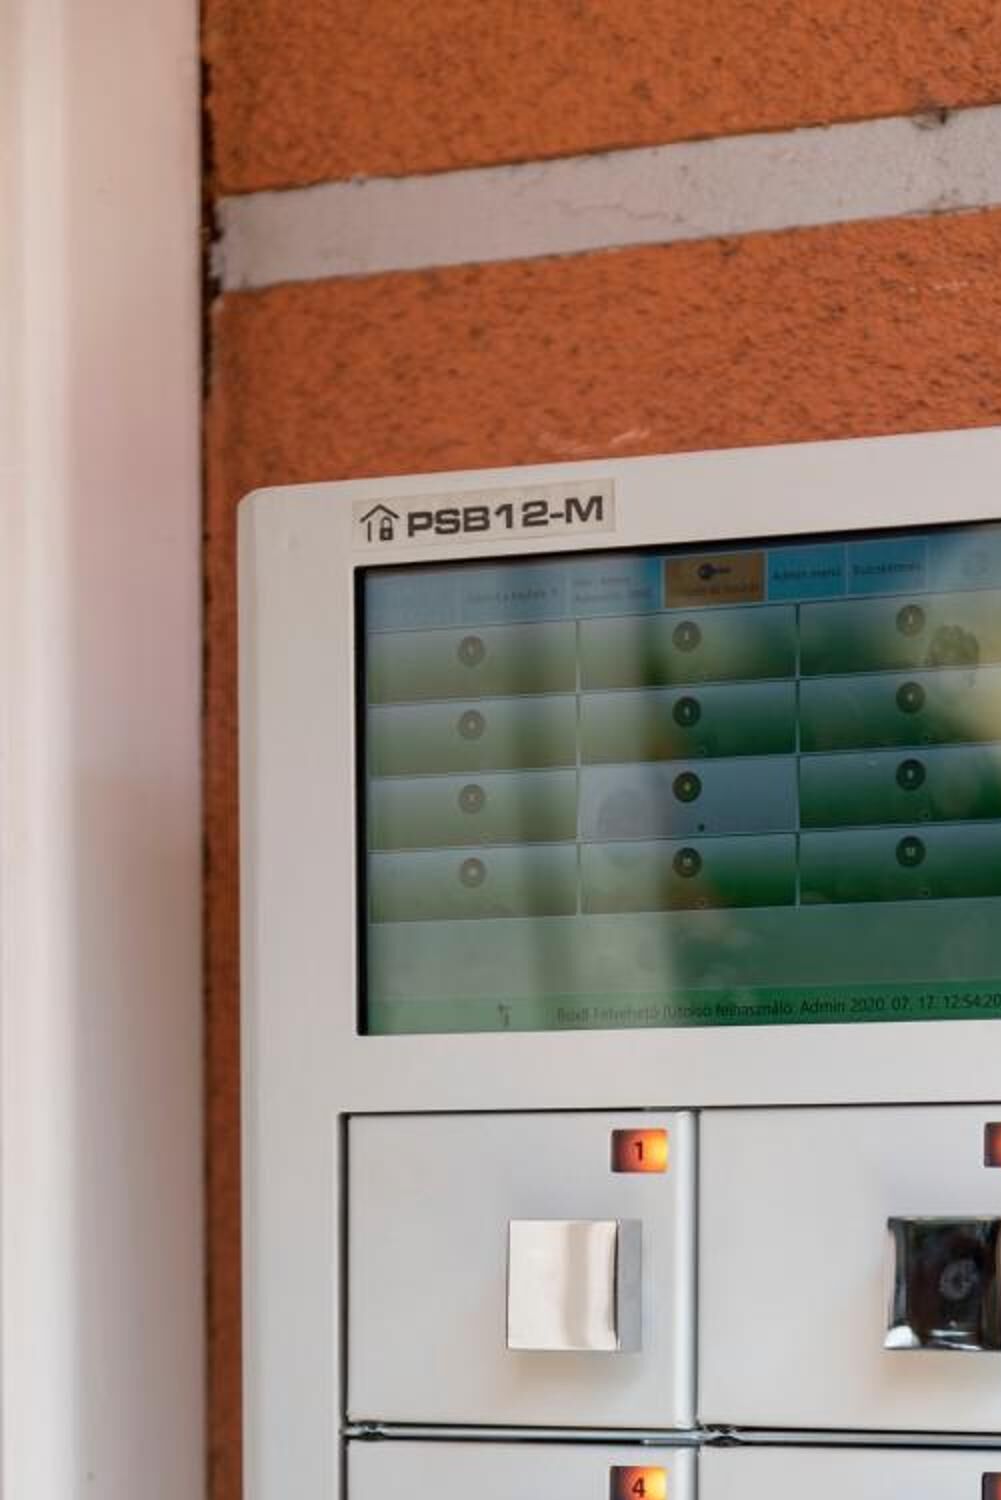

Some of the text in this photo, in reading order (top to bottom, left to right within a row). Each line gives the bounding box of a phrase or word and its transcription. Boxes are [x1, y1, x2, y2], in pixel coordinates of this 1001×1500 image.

[407, 495, 603, 537] PSB12-M
[801, 998, 846, 1014] Admin
[635, 1141, 643, 1161] 1
[632, 1477, 646, 1498] 4
